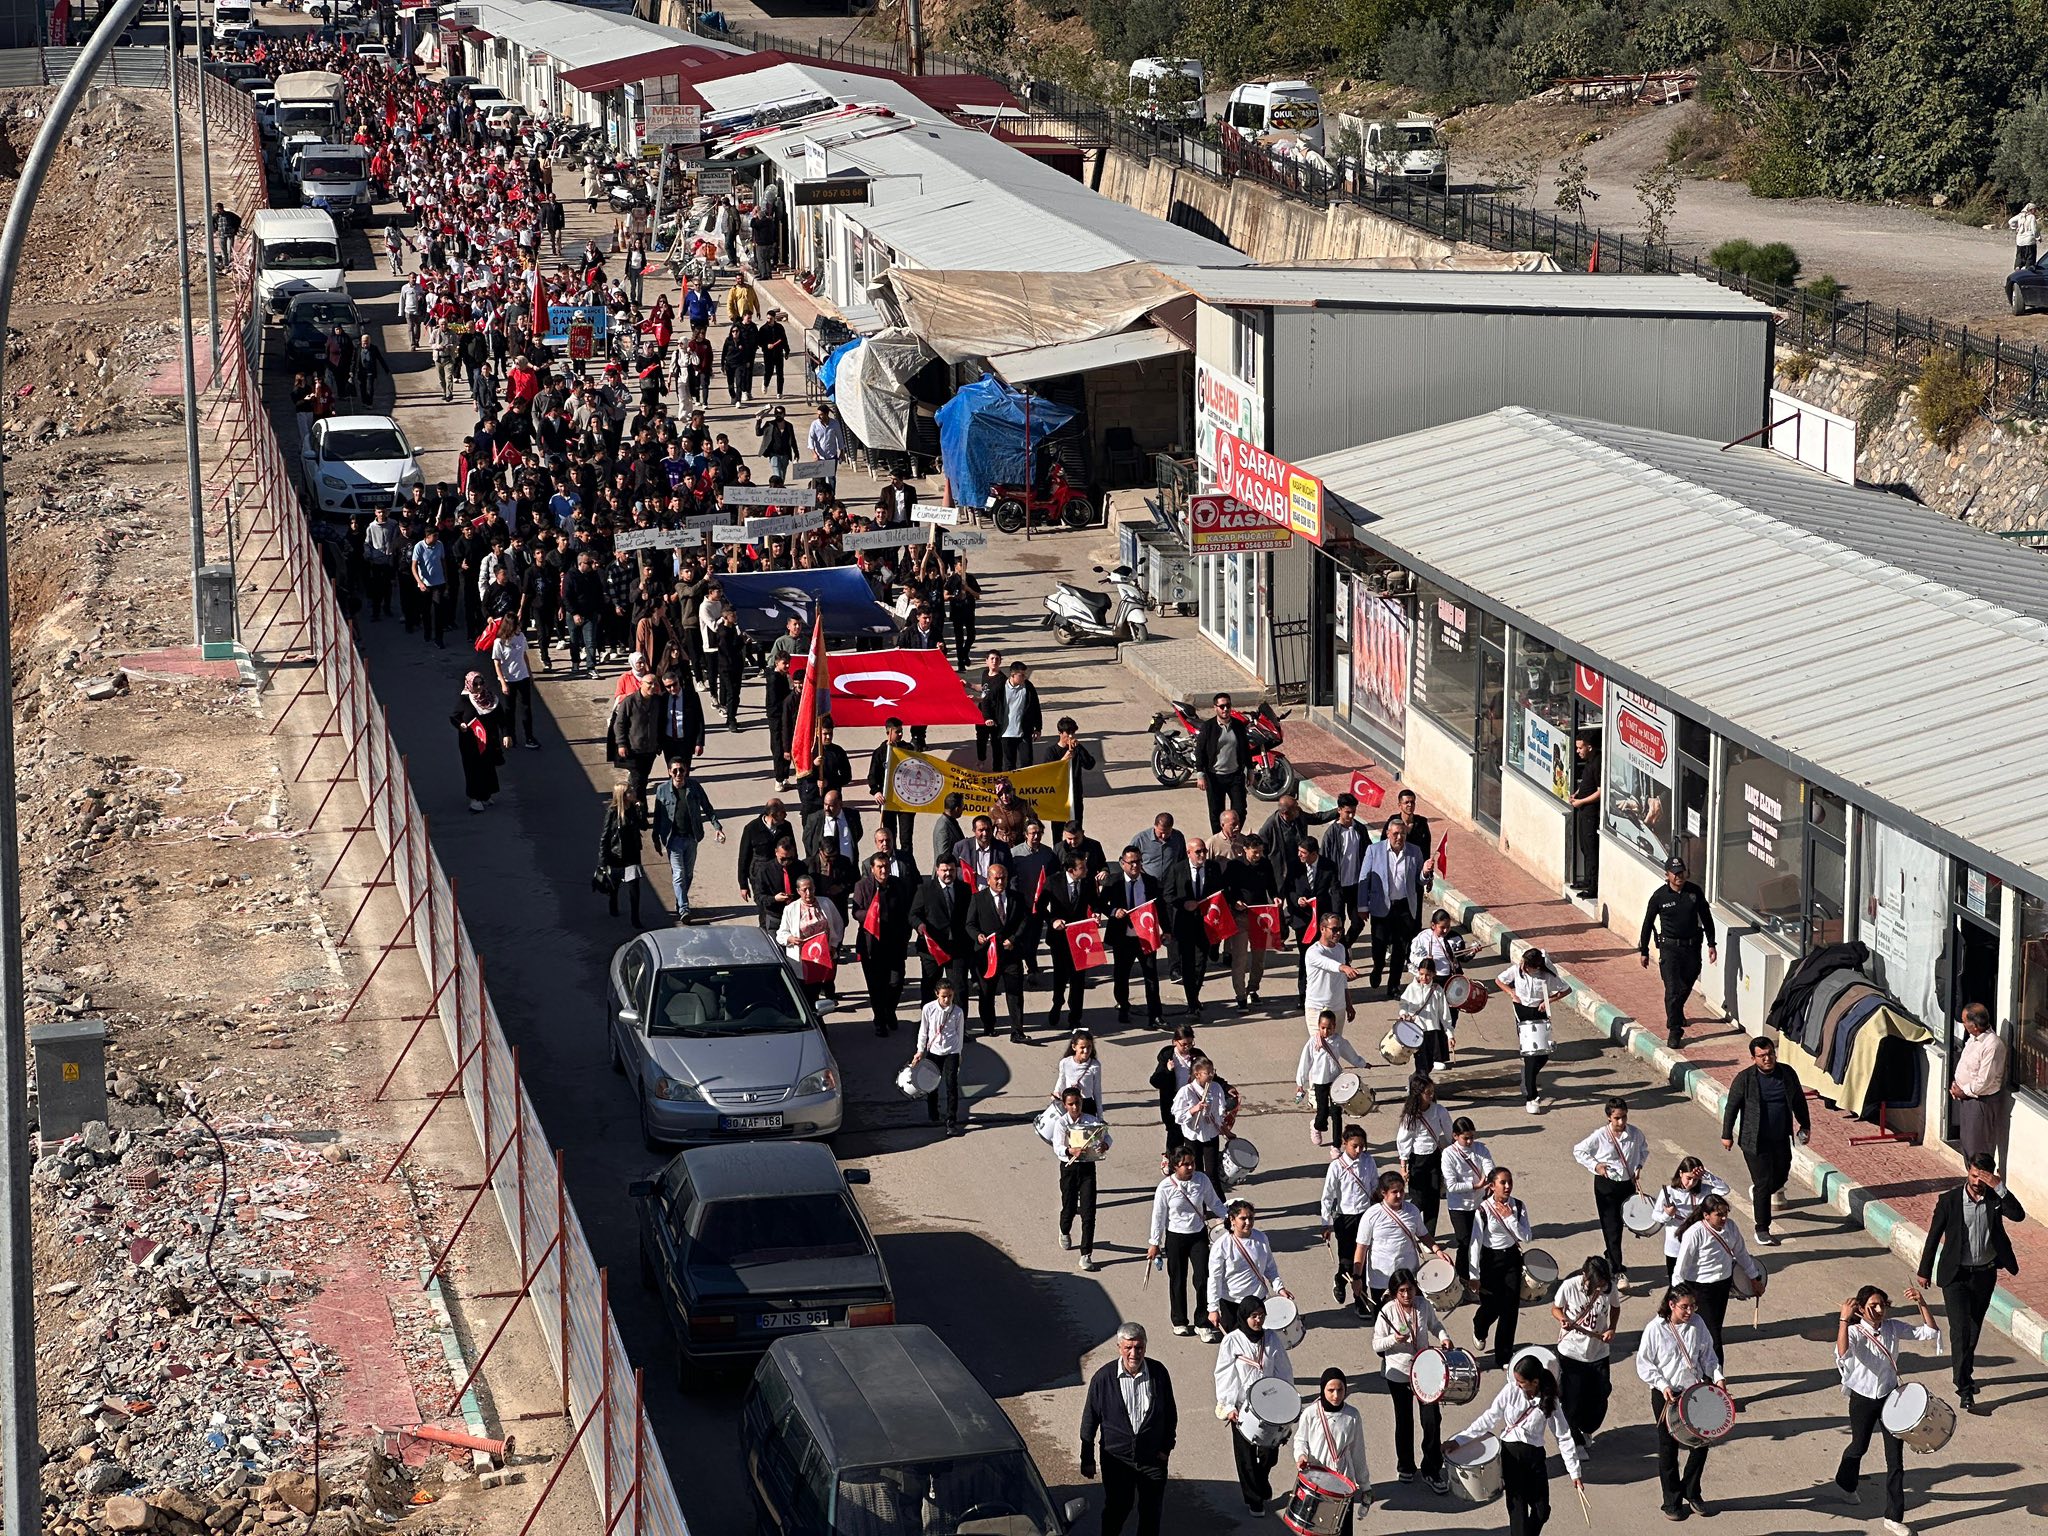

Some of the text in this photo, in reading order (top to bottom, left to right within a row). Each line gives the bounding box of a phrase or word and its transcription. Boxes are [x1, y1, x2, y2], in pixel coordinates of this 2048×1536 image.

[1274, 110, 1295, 118] OKUL
[1198, 366, 1239, 425] GÜLSEVEN
[1239, 443, 1286, 488] SARAY
[1235, 471, 1289, 525] KASABI
[1207, 533, 1235, 543] KASAP
[1210, 543, 1220, 551] 572
[1245, 541, 1260, 549] 0546
[1261, 540, 1274, 548] 938
[1274, 540, 1283, 548] 95
[1283, 539, 1291, 547] 78
[1019, 786, 1056, 795] AKKAYA
[741, 1117, 759, 1128] AAF
[763, 1116, 781, 1126] 168
[763, 1312, 827, 1327] 67 NS 961
